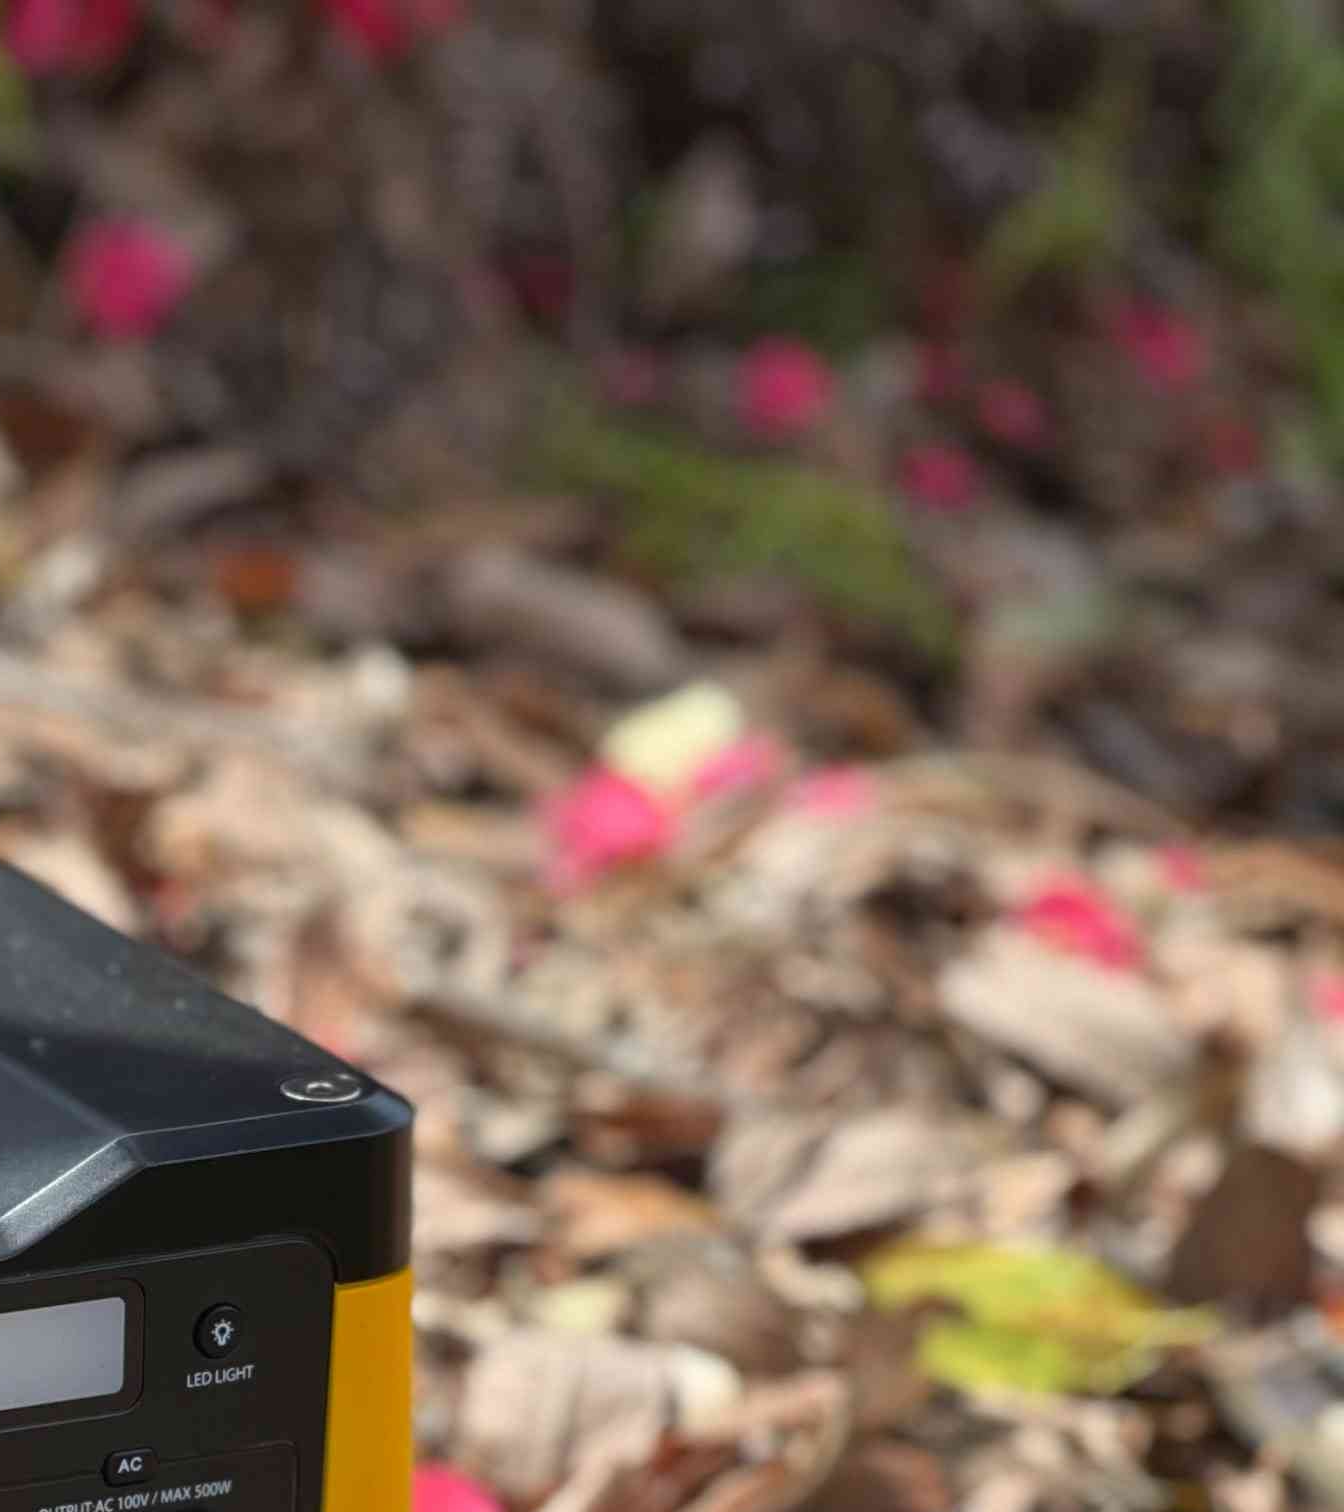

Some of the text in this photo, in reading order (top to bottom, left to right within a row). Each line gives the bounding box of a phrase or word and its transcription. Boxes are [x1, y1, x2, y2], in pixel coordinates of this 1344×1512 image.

[186, 1364, 256, 1388] LED LIGHT
[118, 1457, 143, 1474] AC
[117, 1493, 150, 1511] 100V
[160, 1486, 191, 1504] MAX
[194, 1480, 233, 1500] 500W
